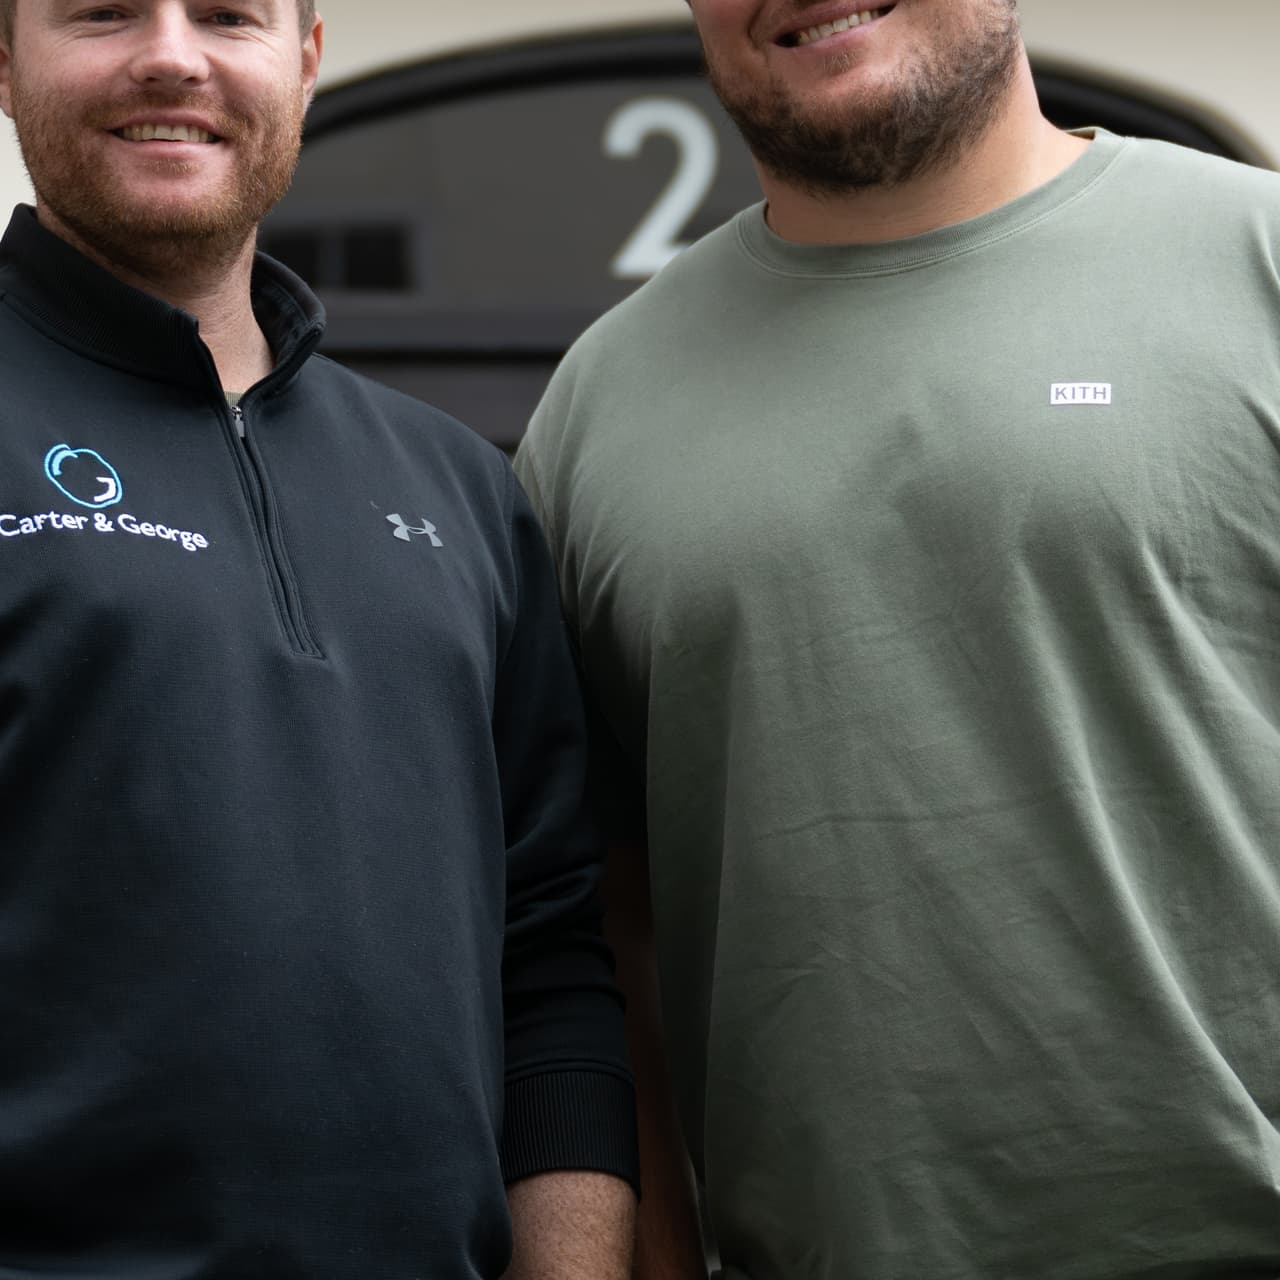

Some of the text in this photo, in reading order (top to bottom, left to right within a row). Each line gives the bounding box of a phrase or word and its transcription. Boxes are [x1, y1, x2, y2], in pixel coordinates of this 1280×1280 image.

[604, 96, 717, 277] 2
[1055, 385, 1107, 401] KITH
[93, 511, 116, 533] &
[116, 513, 209, 552] George
